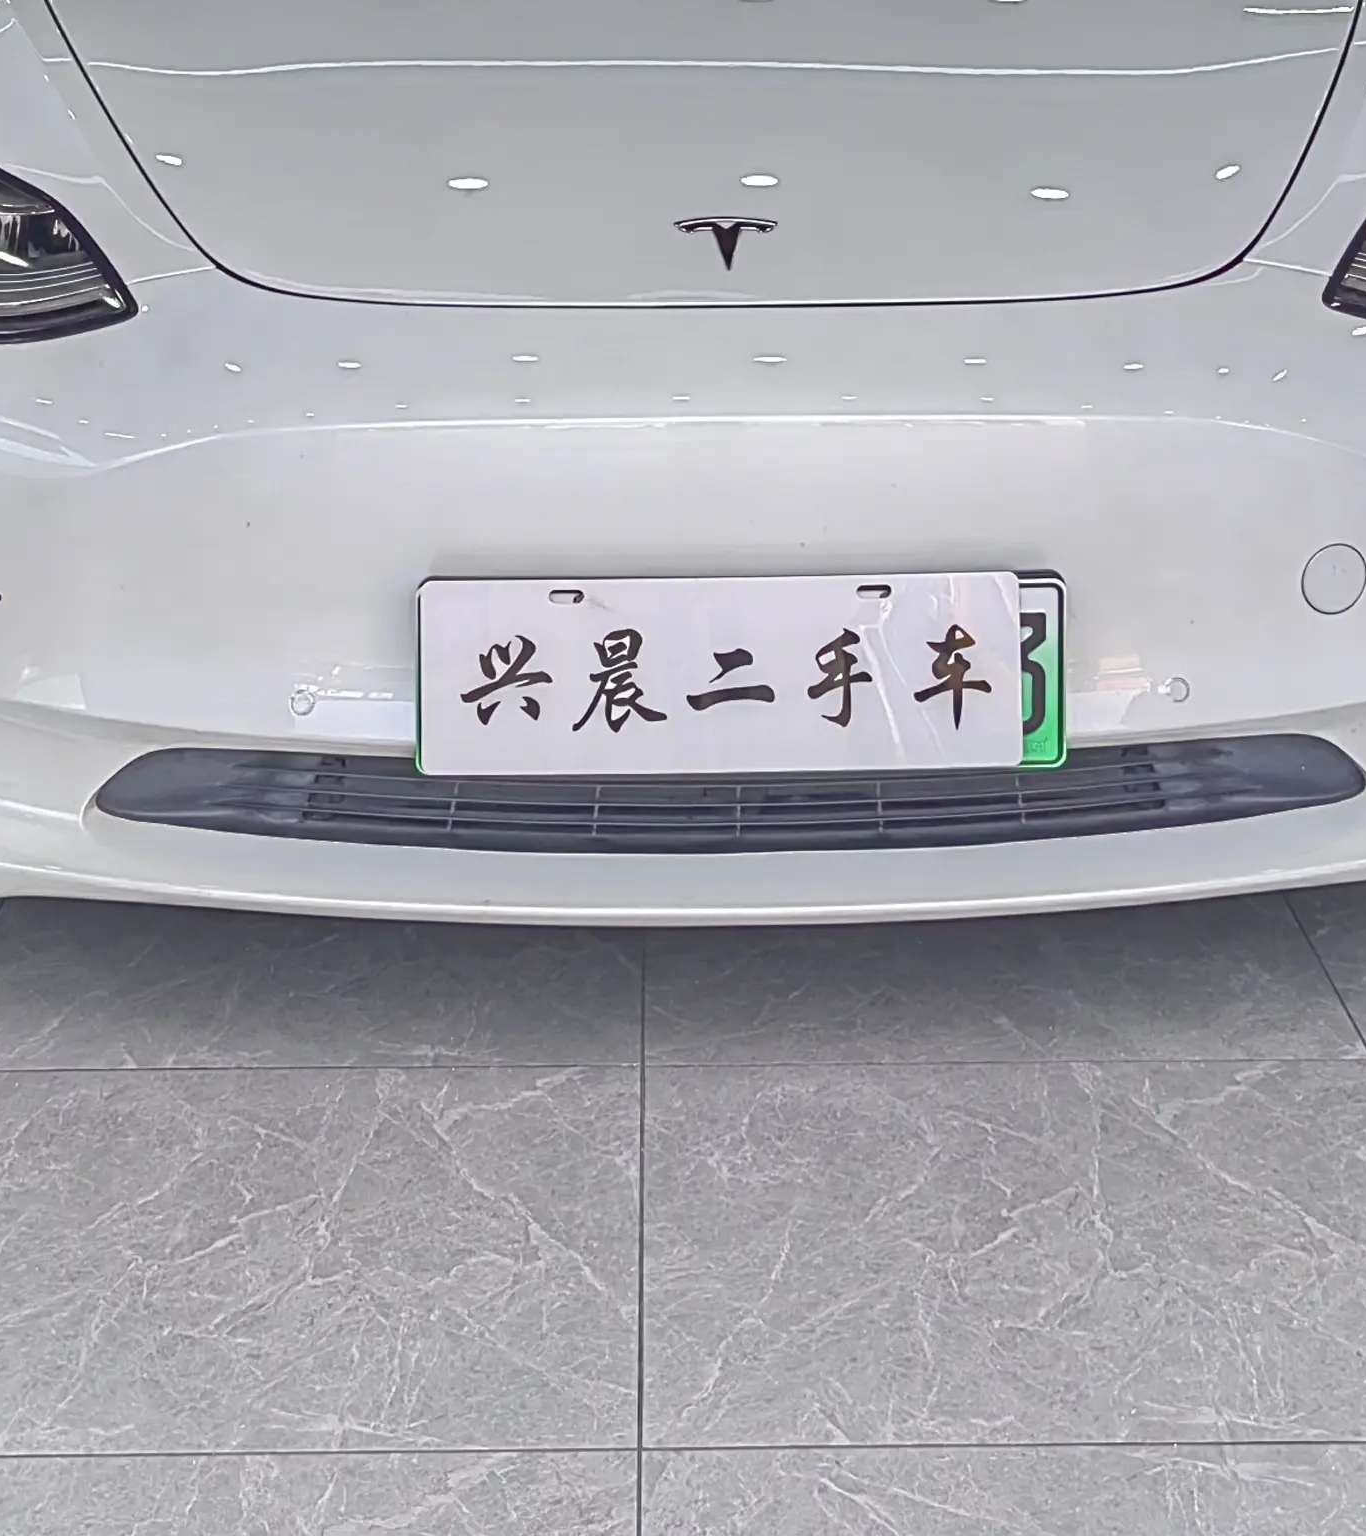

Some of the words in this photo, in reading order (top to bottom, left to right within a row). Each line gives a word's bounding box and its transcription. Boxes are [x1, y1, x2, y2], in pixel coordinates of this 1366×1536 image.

[460, 624, 992, 734] 兴晨二手车
